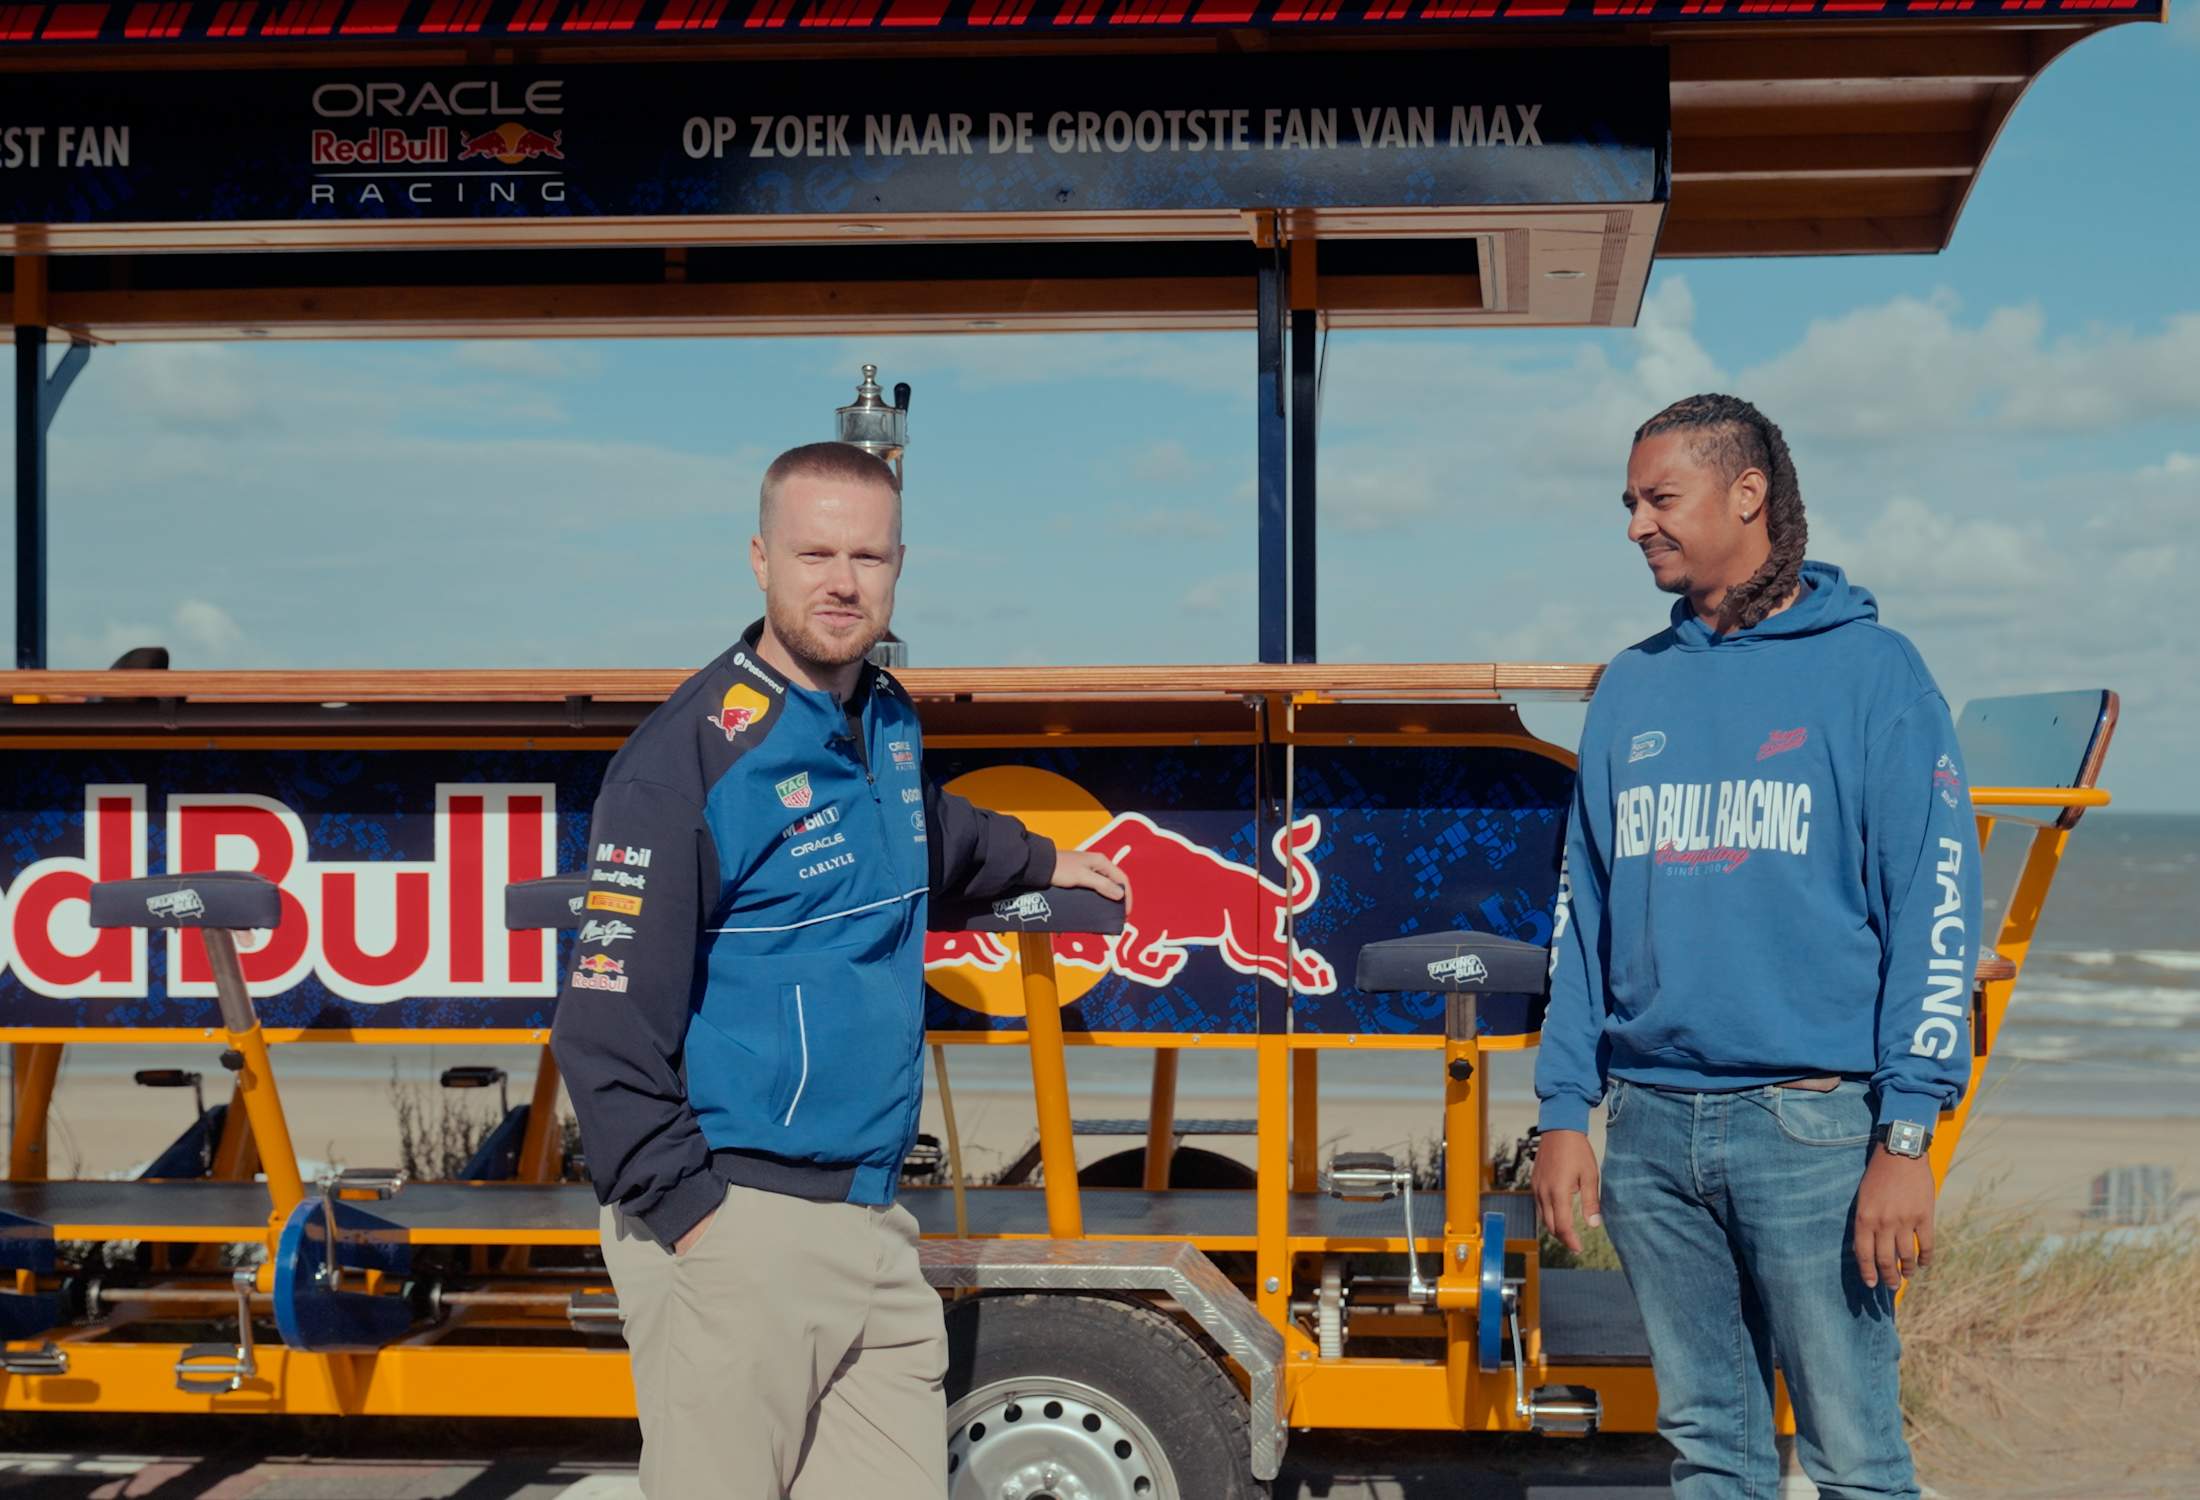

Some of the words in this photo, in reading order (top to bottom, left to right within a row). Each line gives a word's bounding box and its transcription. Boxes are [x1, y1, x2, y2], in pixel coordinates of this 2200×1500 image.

[312, 80, 564, 117] ORACLE
[683, 116, 736, 158] OP
[749, 115, 850, 158] ZOEK
[865, 113, 973, 156] NAAR
[988, 112, 1034, 155] DE
[1048, 109, 1249, 153] GROOTSTE
[1264, 108, 1337, 150] FAN
[1352, 106, 1434, 149] VAN
[1449, 104, 1542, 147] MAX
[0, 126, 45, 168] ST
[58, 126, 130, 167] FAN
[312, 182, 565, 203] RACING
[779, 775, 806, 796] TAG
[782, 811, 824, 839] Mobil
[1615, 785, 1655, 858] RED
[1655, 782, 1712, 852] BULL
[1713, 778, 1812, 856] RACING
[596, 843, 651, 867] Mobil
[791, 832, 846, 857] ORACLE
[799, 852, 855, 879] CARLYLE
[1020, 902, 1047, 916] BULL
[1910, 837, 1965, 1060] RACING
[1428, 956, 1477, 975] TALKING
[1456, 964, 1482, 978] BULL
